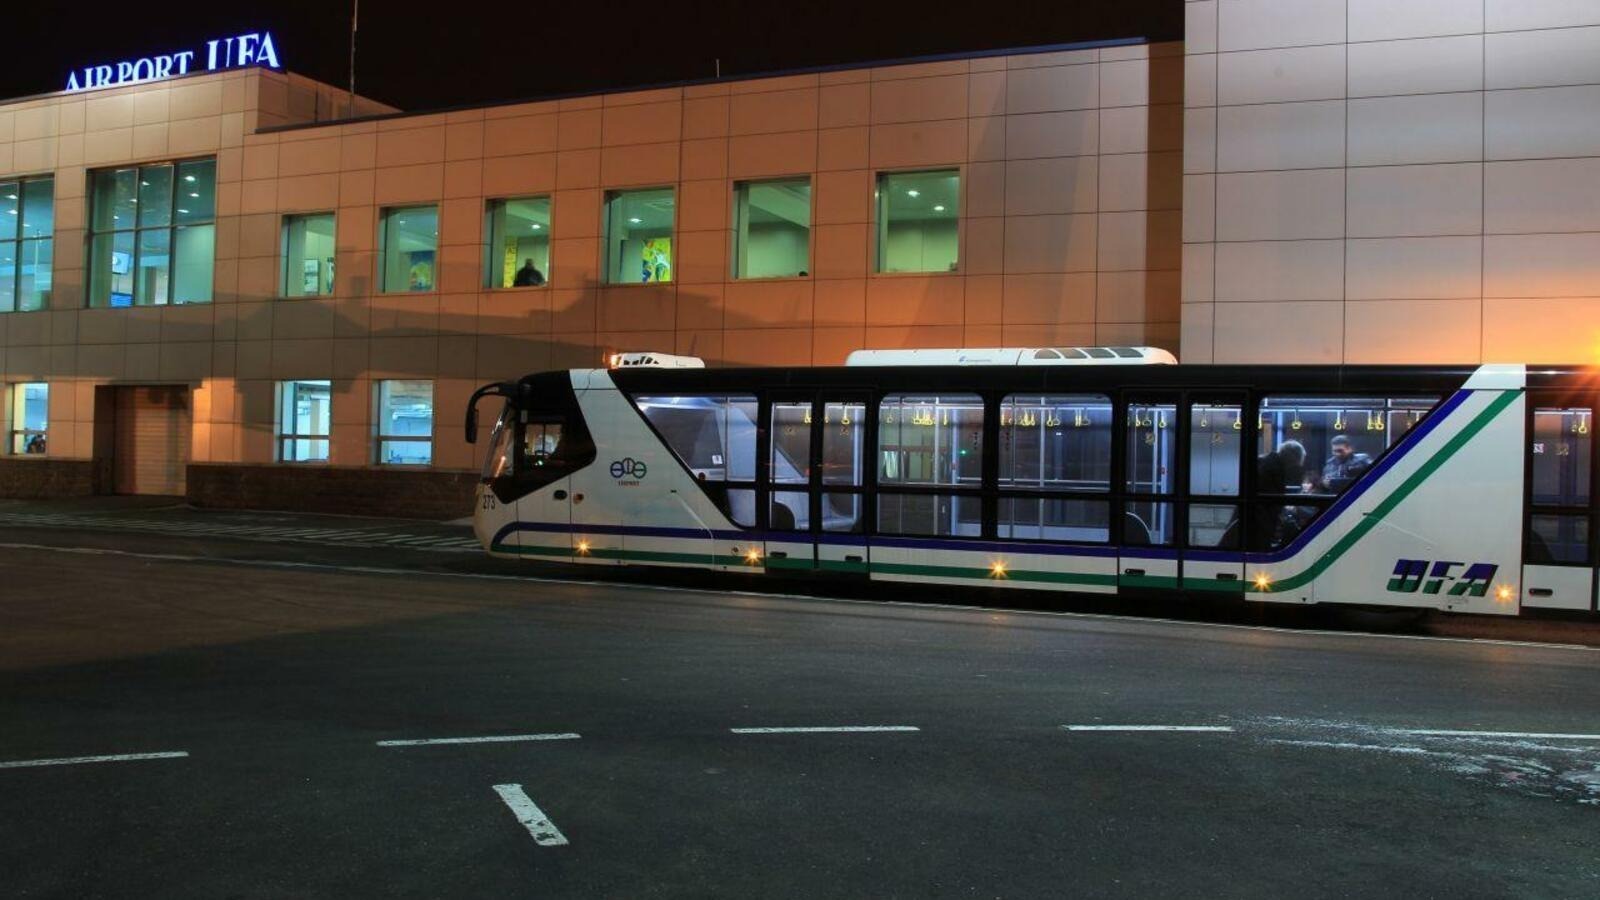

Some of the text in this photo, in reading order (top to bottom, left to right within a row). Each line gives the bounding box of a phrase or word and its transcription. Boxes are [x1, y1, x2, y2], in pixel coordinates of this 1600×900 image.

[65, 31, 280, 92] AIRPORT UFA
[1386, 559, 1499, 597] UFA
